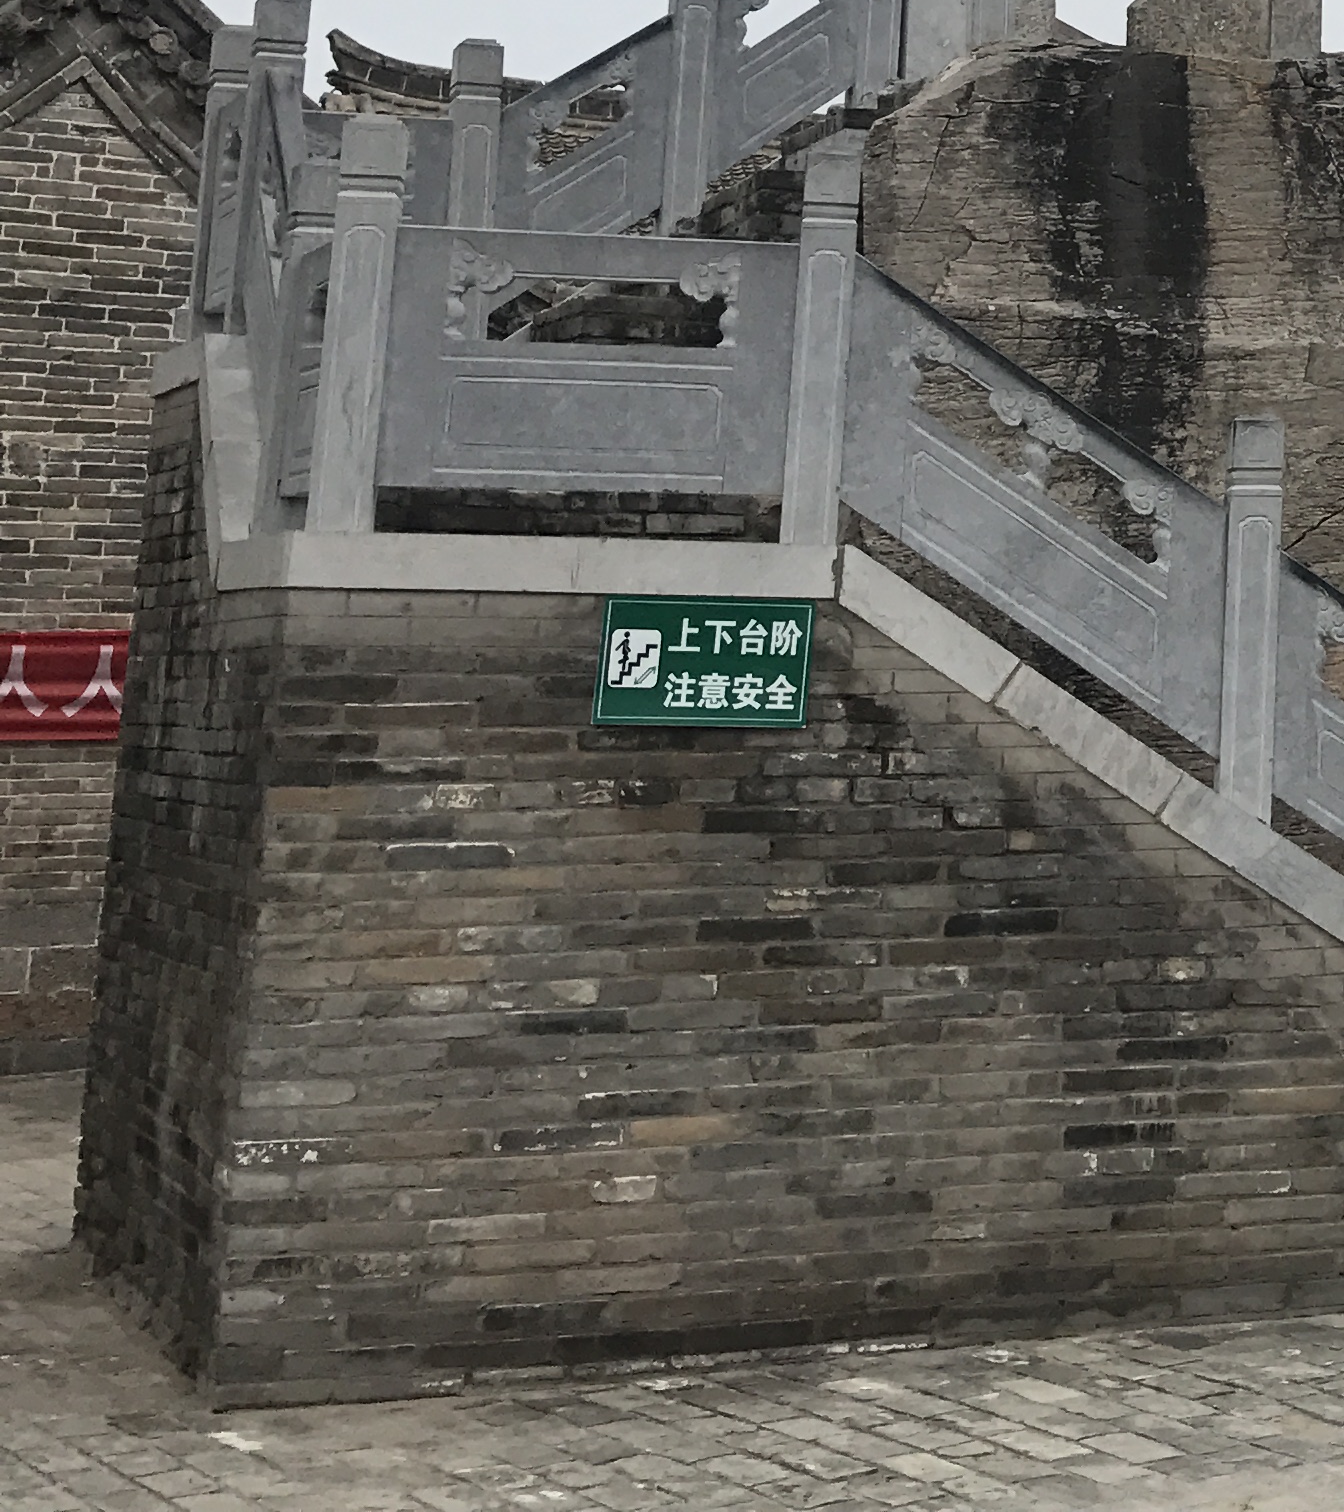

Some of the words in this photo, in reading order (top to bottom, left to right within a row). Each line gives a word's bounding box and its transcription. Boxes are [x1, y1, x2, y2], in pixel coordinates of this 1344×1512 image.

[667, 617, 803, 656] 上下台阶
[663, 671, 798, 710] 注意安全
